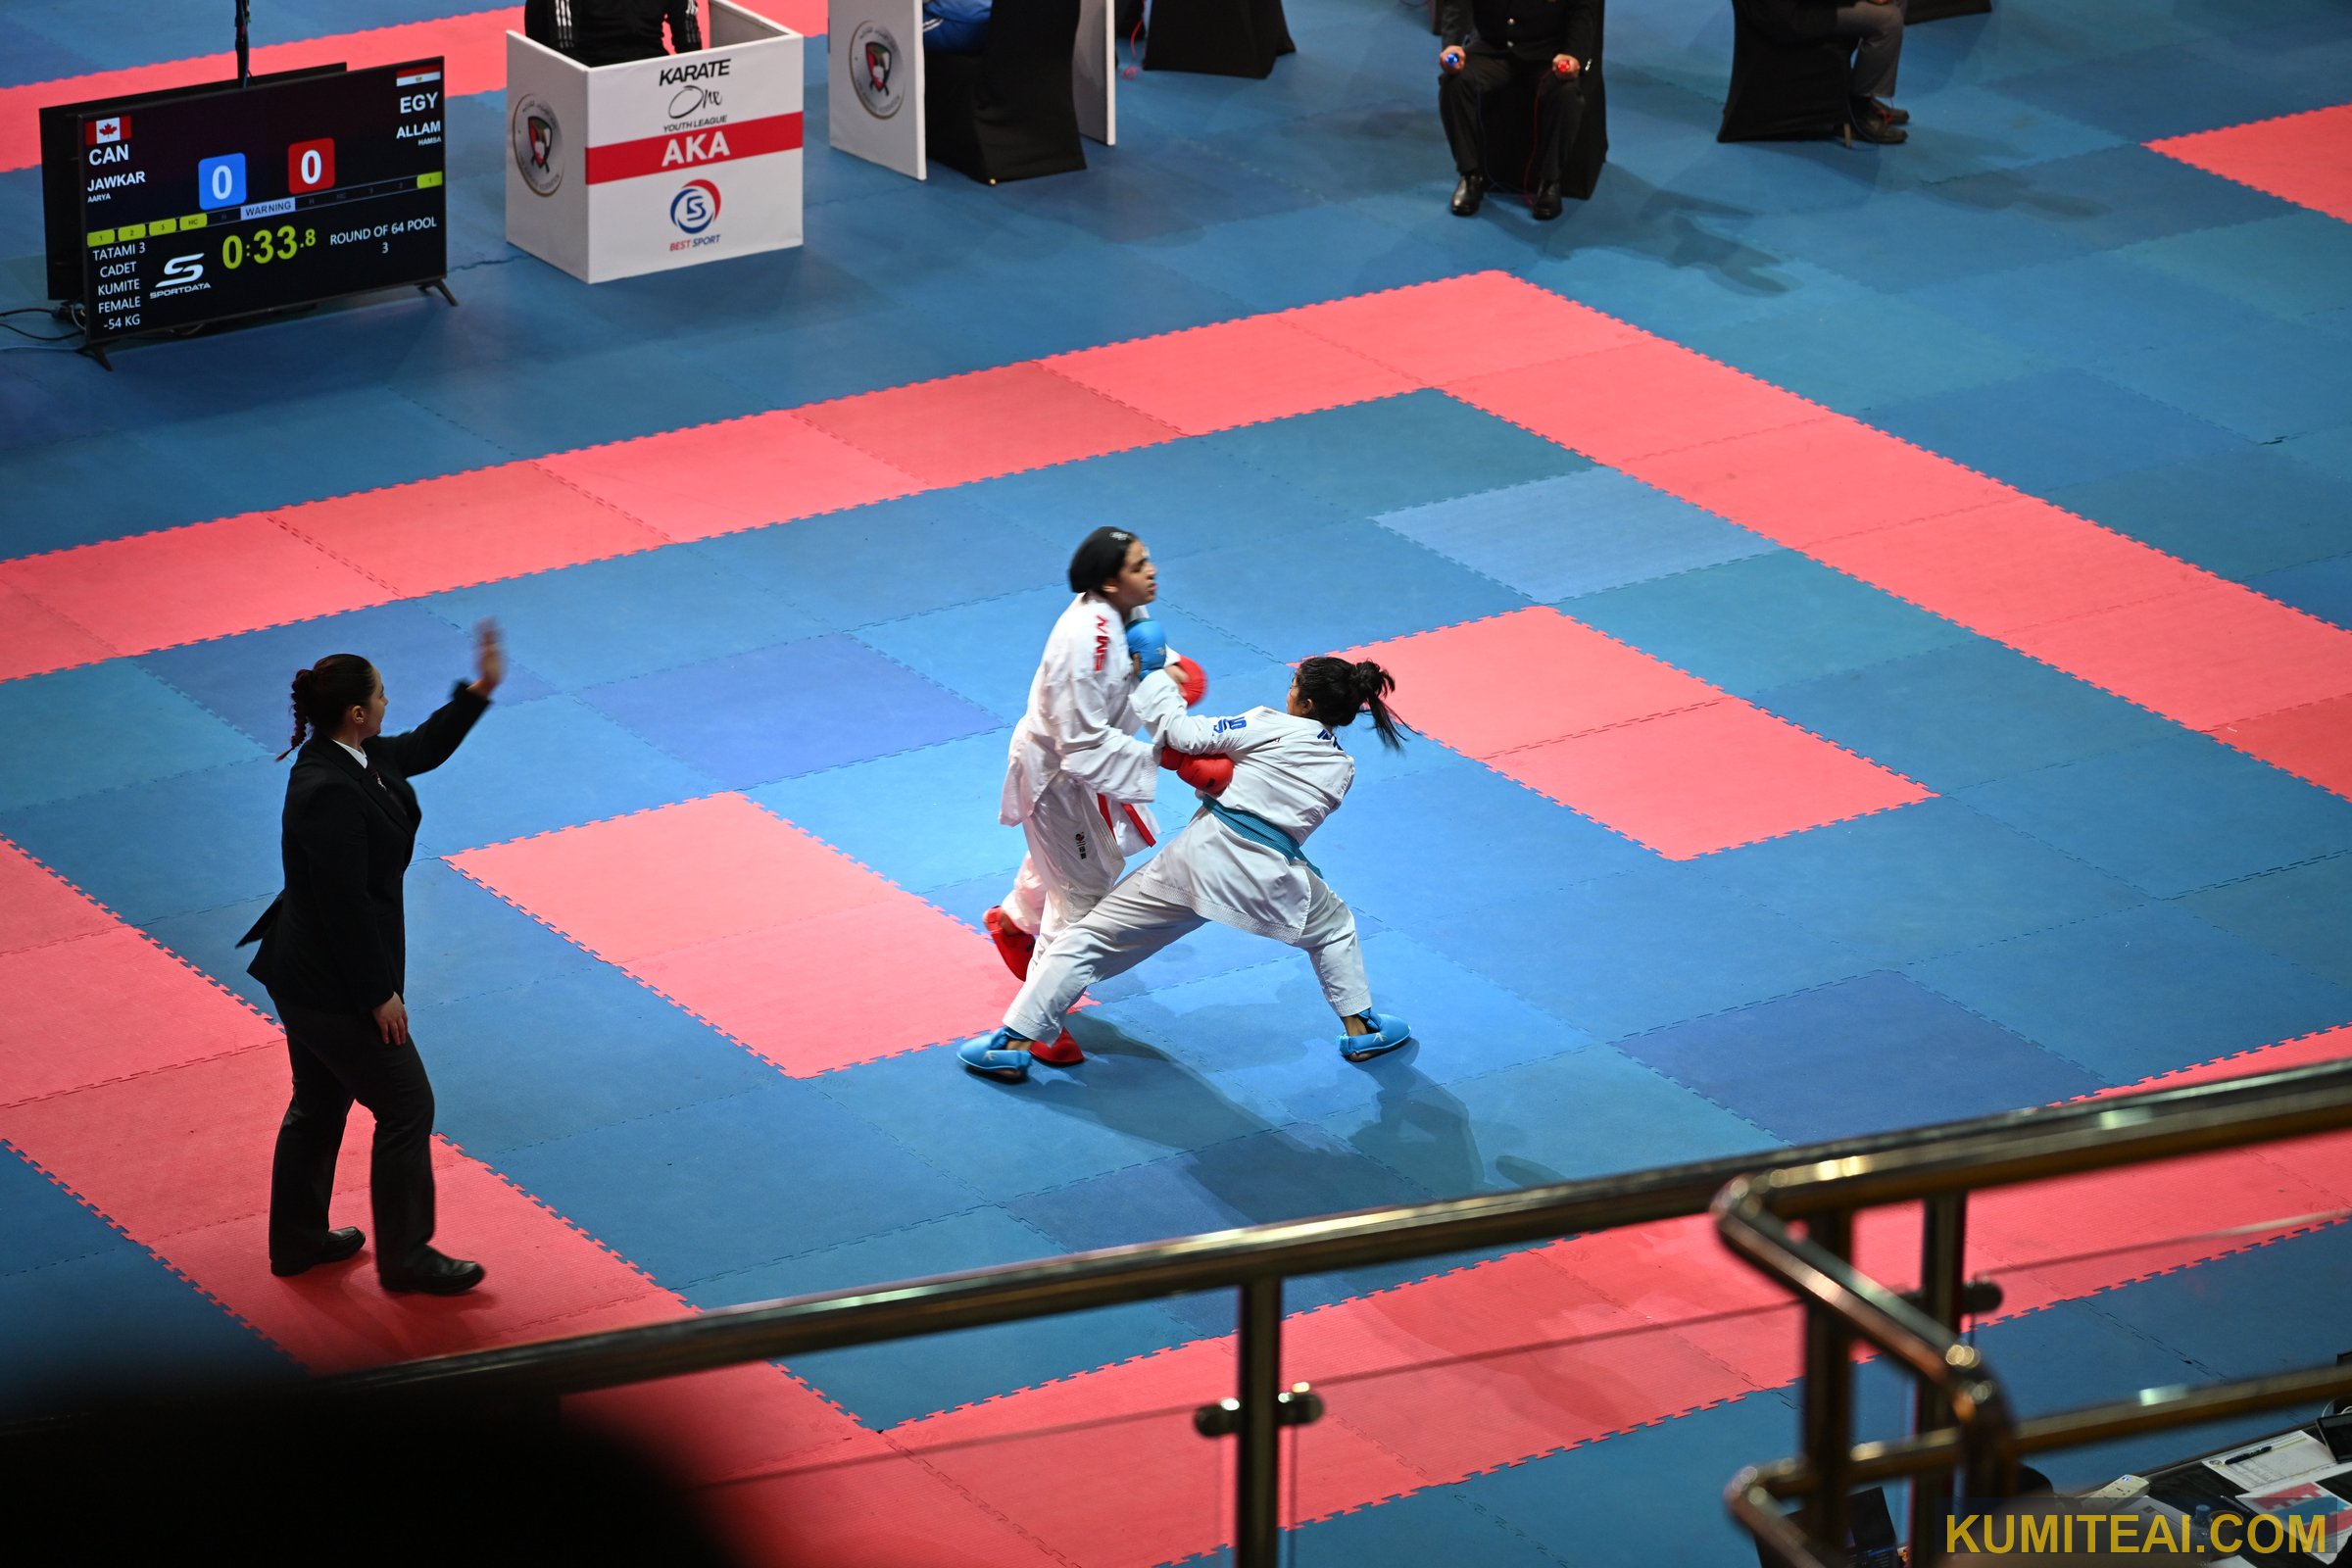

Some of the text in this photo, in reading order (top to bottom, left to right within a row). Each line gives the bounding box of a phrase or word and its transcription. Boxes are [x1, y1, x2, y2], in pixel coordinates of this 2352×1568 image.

[659, 58, 731, 86] KARATE
[400, 91, 439, 114] EGY
[396, 120, 441, 139] ALLAM
[663, 115, 728, 132] YOUTH LEAGUE
[88, 143, 129, 166] CAN
[662, 130, 730, 167] AKA
[301, 150, 321, 184] 0
[87, 171, 146, 192] JAWKAR
[212, 165, 232, 200] 0
[87, 193, 111, 203] AARYA
[245, 201, 291, 217] WARNING
[330, 216, 437, 246] ROUND OF 64 POOL
[92, 241, 146, 261] TATAMI 3
[381, 241, 389, 254] 3
[669, 234, 721, 252] BEST SPORT
[100, 261, 137, 278] CADET
[98, 278, 140, 296] KUMITE
[149, 281, 212, 299] SPORTDATA
[98, 296, 141, 314] FEMALE
[103, 314, 141, 330] -54 KG
